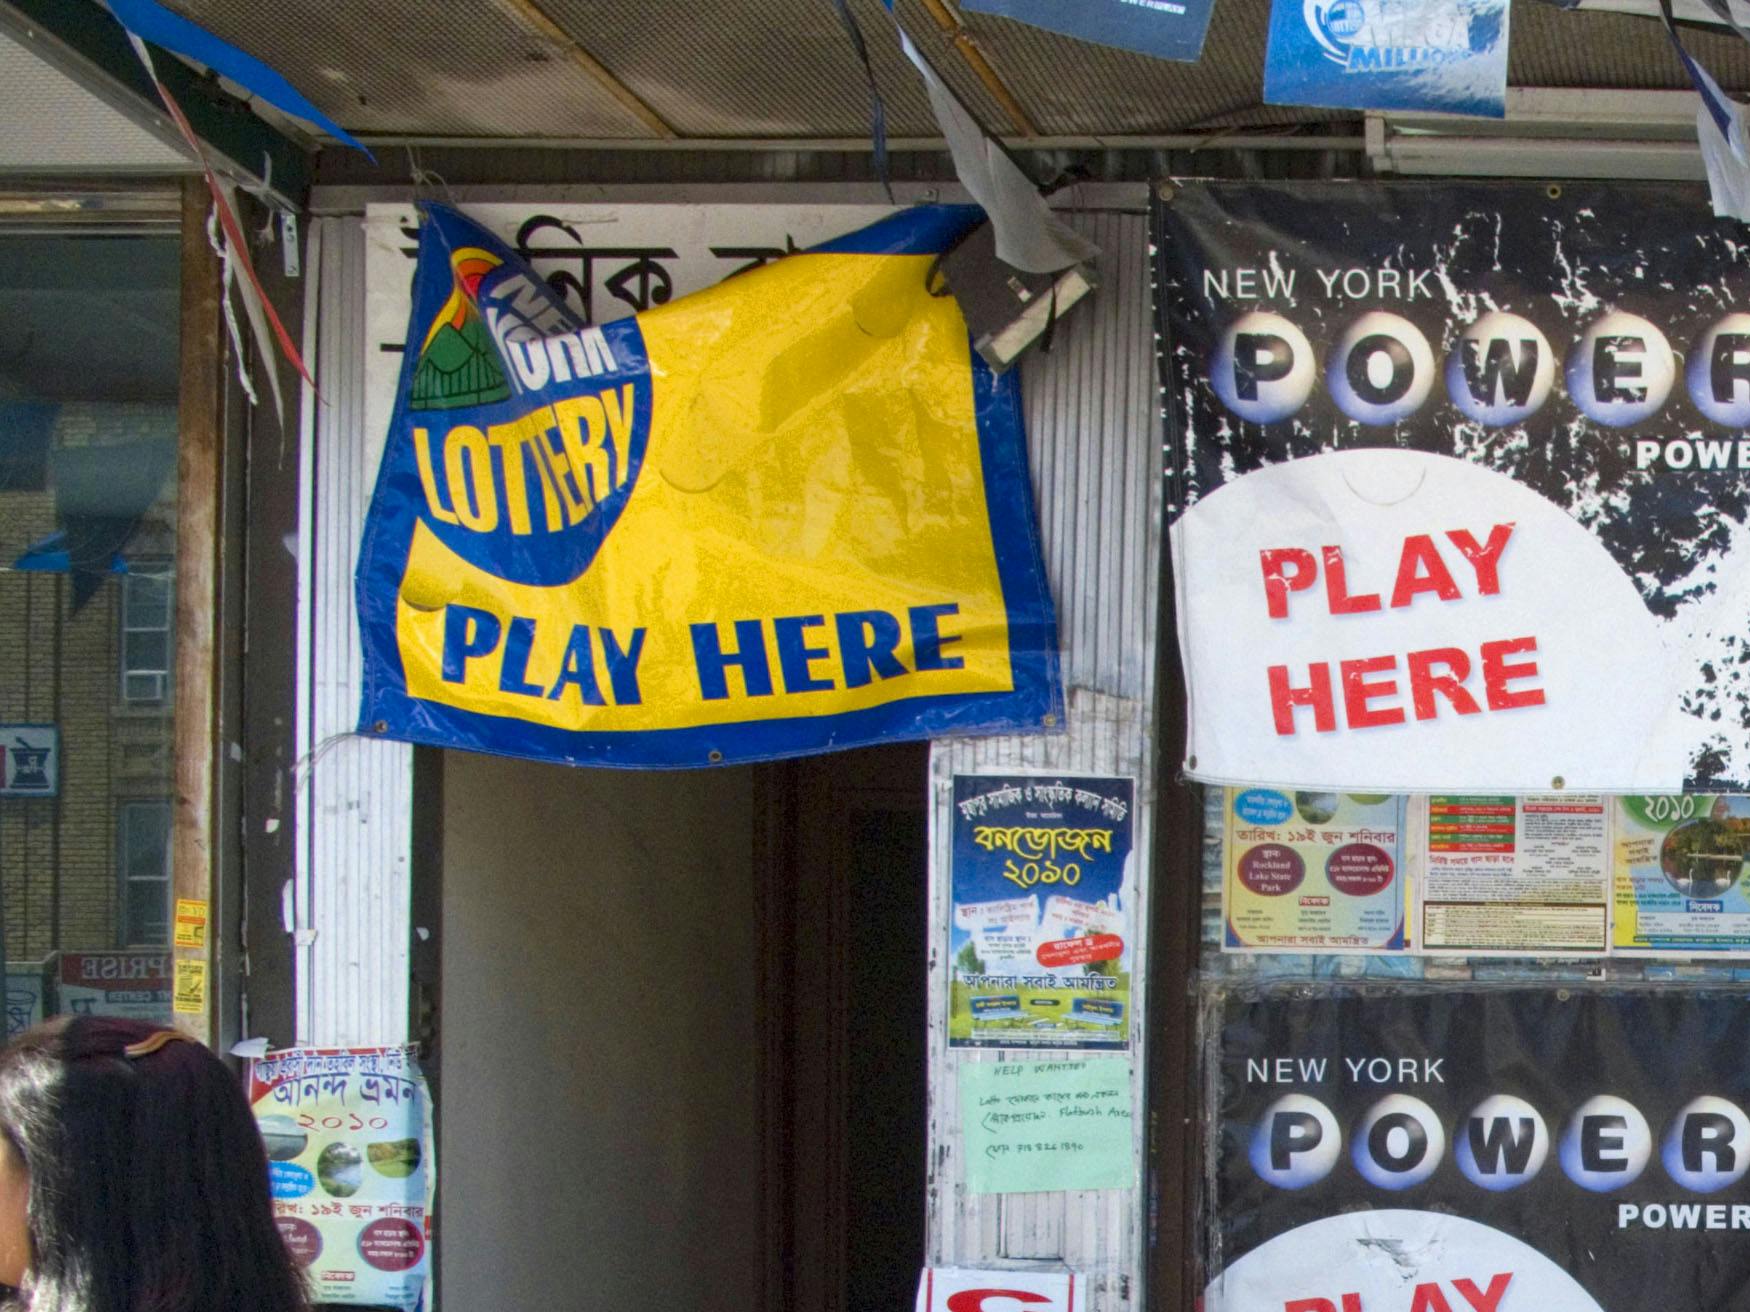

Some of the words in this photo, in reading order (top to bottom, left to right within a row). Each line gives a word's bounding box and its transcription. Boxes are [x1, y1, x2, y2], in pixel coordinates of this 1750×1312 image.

[1203, 269, 1296, 299] NEW
[1317, 269, 1433, 299] YORK
[413, 383, 635, 535] LOTTERY
[1258, 520, 1516, 620] PLAY
[442, 603, 647, 706] PLAY
[689, 602, 967, 701] HERE
[1267, 636, 1547, 736] HERE
[1236, 828, 1281, 842] তারিখ:
[1321, 830, 1343, 845] জুন
[1349, 829, 1396, 844] শনিবার
[1002, 859, 1081, 889] ২০১০
[963, 974, 1018, 990] আপনারা
[1023, 973, 1057, 989] সবাই
[1062, 971, 1119, 991] আমন্ত্রিত
[993, 1065, 1024, 1076] HELP
[1246, 1058, 1328, 1084] NEW
[1344, 1058, 1446, 1084] YORK
[273, 1071, 351, 1107] আনন্দ
[359, 1071, 418, 1107] ভ্রমন
[297, 1113, 389, 1133] ২০১০
[348, 1204, 372, 1218] জুন
[378, 1201, 424, 1217] শনিবার
